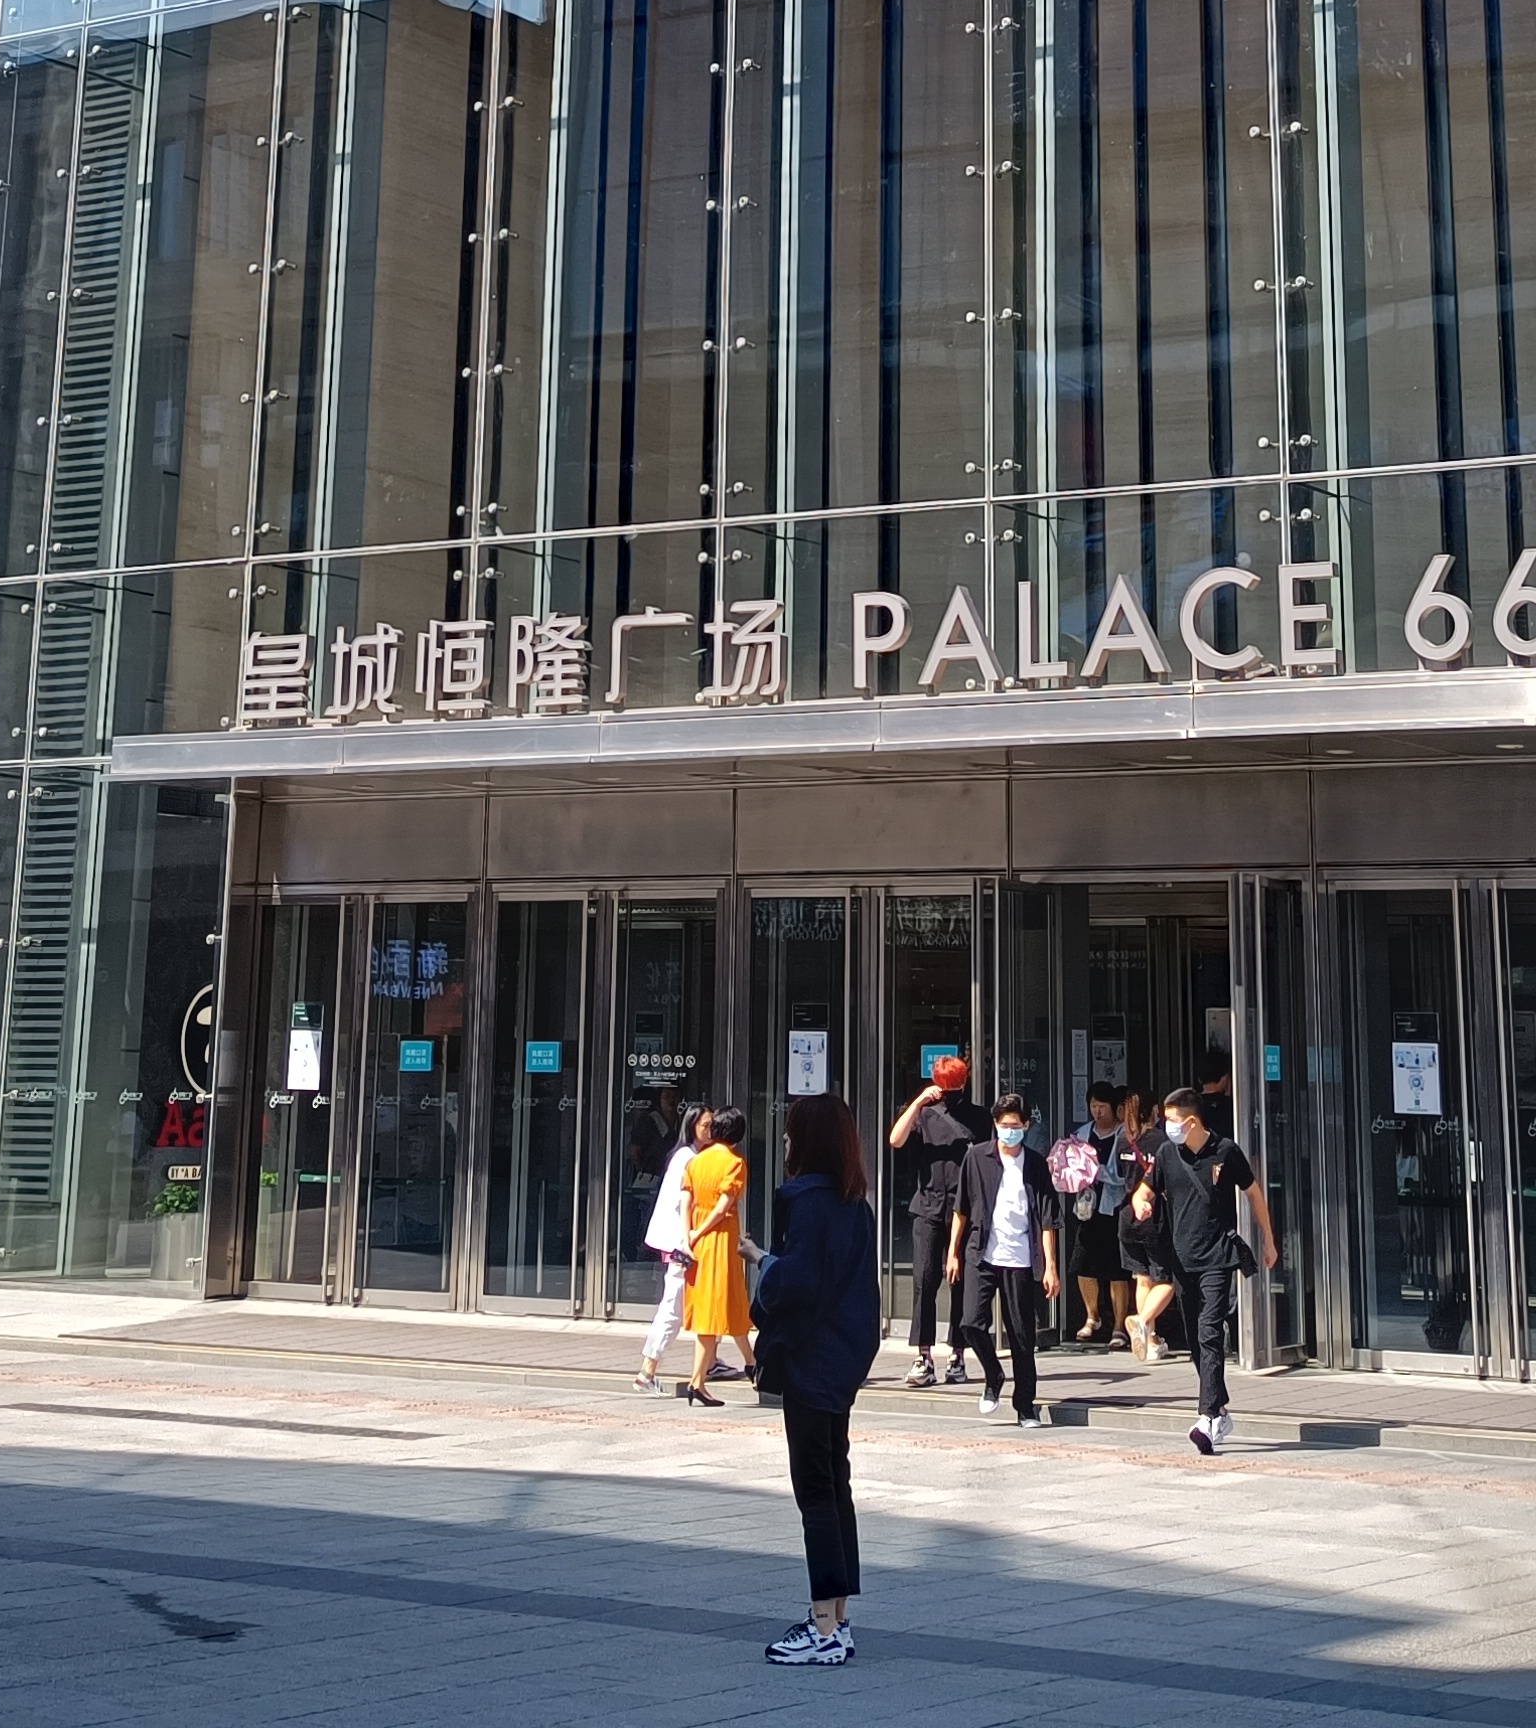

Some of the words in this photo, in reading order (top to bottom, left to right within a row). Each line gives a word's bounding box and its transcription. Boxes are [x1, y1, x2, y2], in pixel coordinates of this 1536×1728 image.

[240, 599, 788, 724] 皇城恒隆广场
[852, 560, 1346, 690] PALACE
